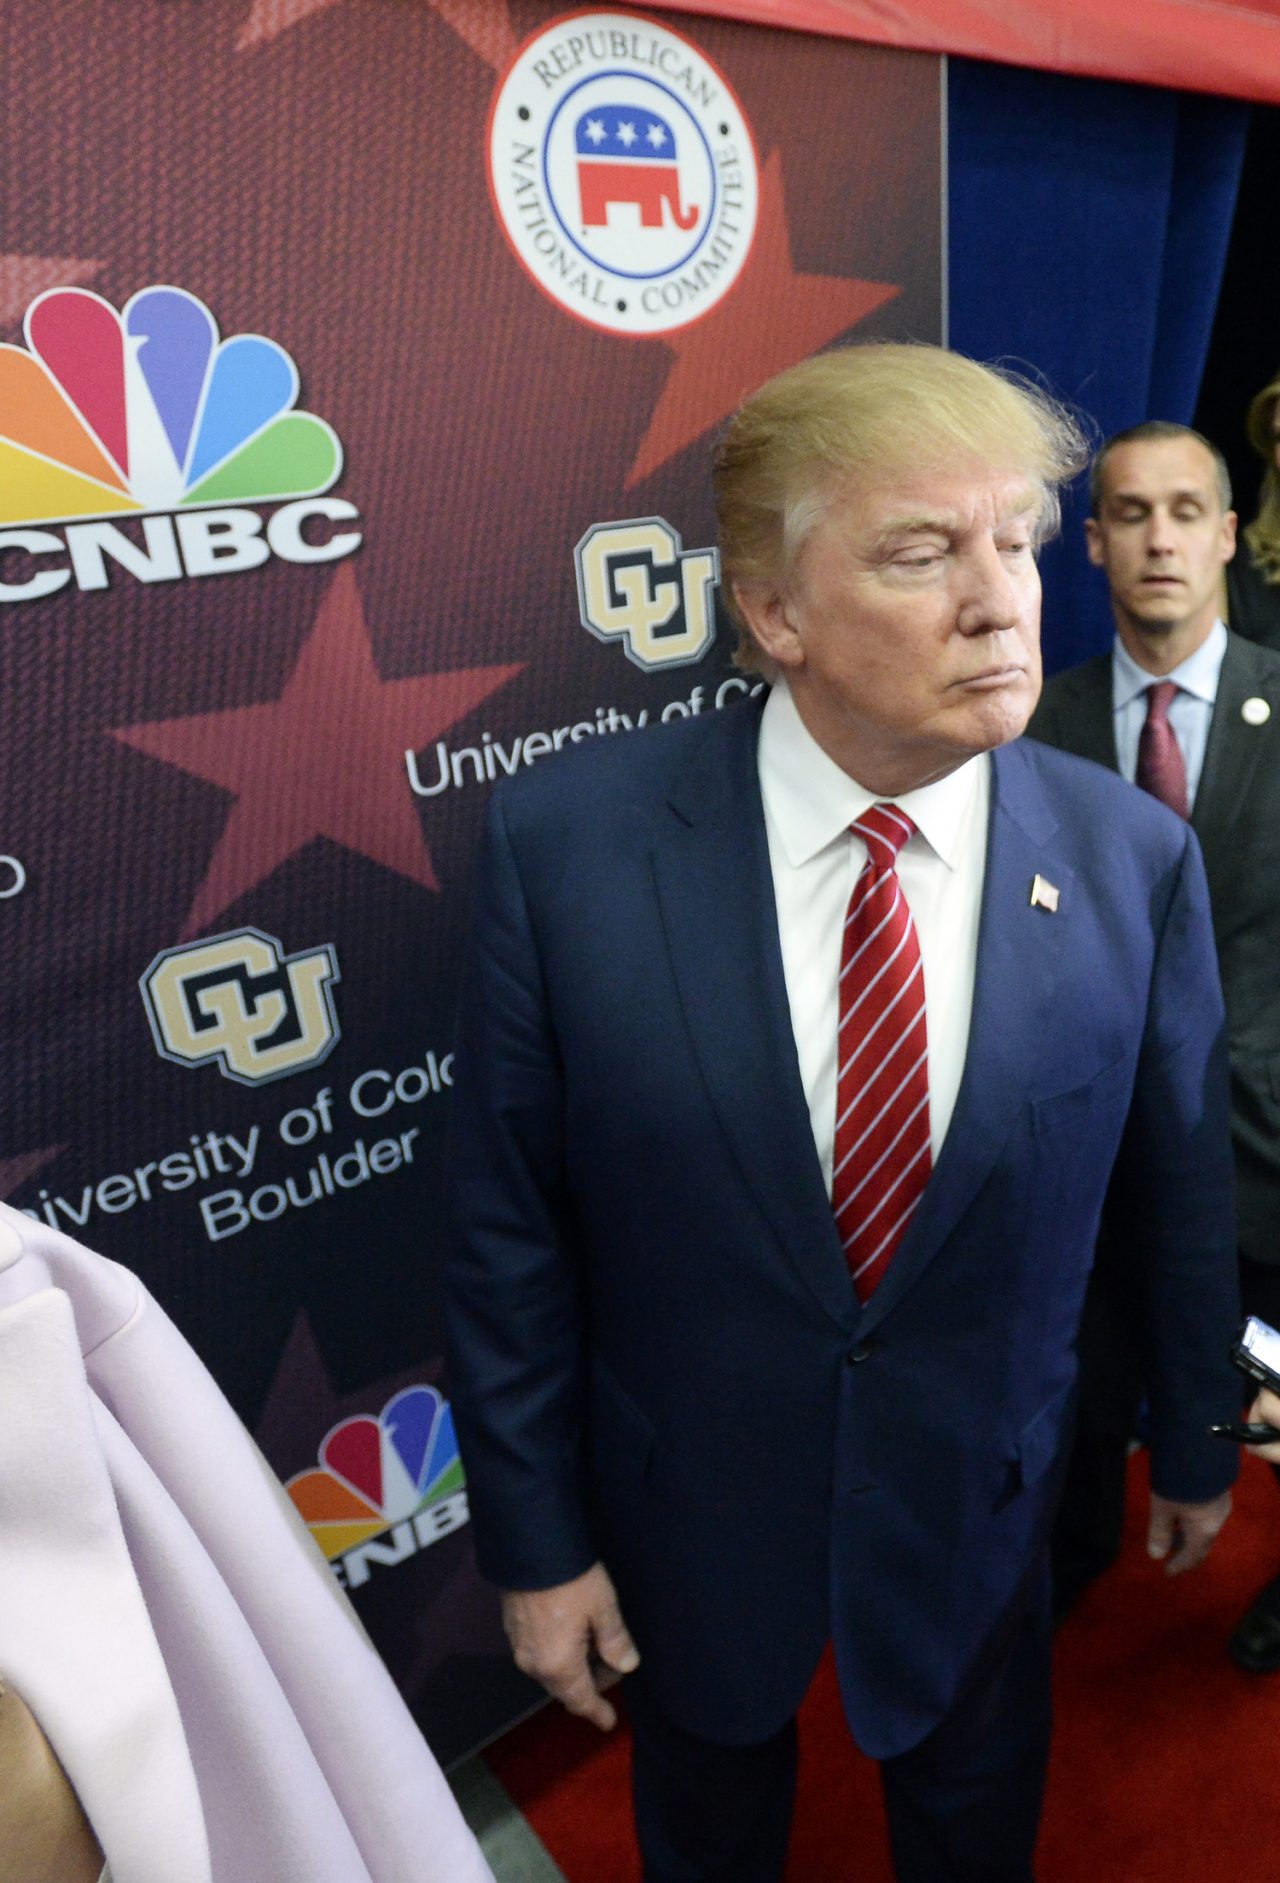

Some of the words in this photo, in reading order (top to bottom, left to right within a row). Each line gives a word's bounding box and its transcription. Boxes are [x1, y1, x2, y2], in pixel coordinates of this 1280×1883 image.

[532, 29, 718, 107] REPUBLICAN
[512, 142, 607, 306] NATIONAL
[641, 145, 742, 312] COMMITTEE
[0, 497, 362, 602] CNBC
[20, 1124, 261, 1232] iversity
[279, 1086, 334, 1146] of
[199, 1127, 420, 1242] Boulder
[329, 1490, 472, 1590] NB
